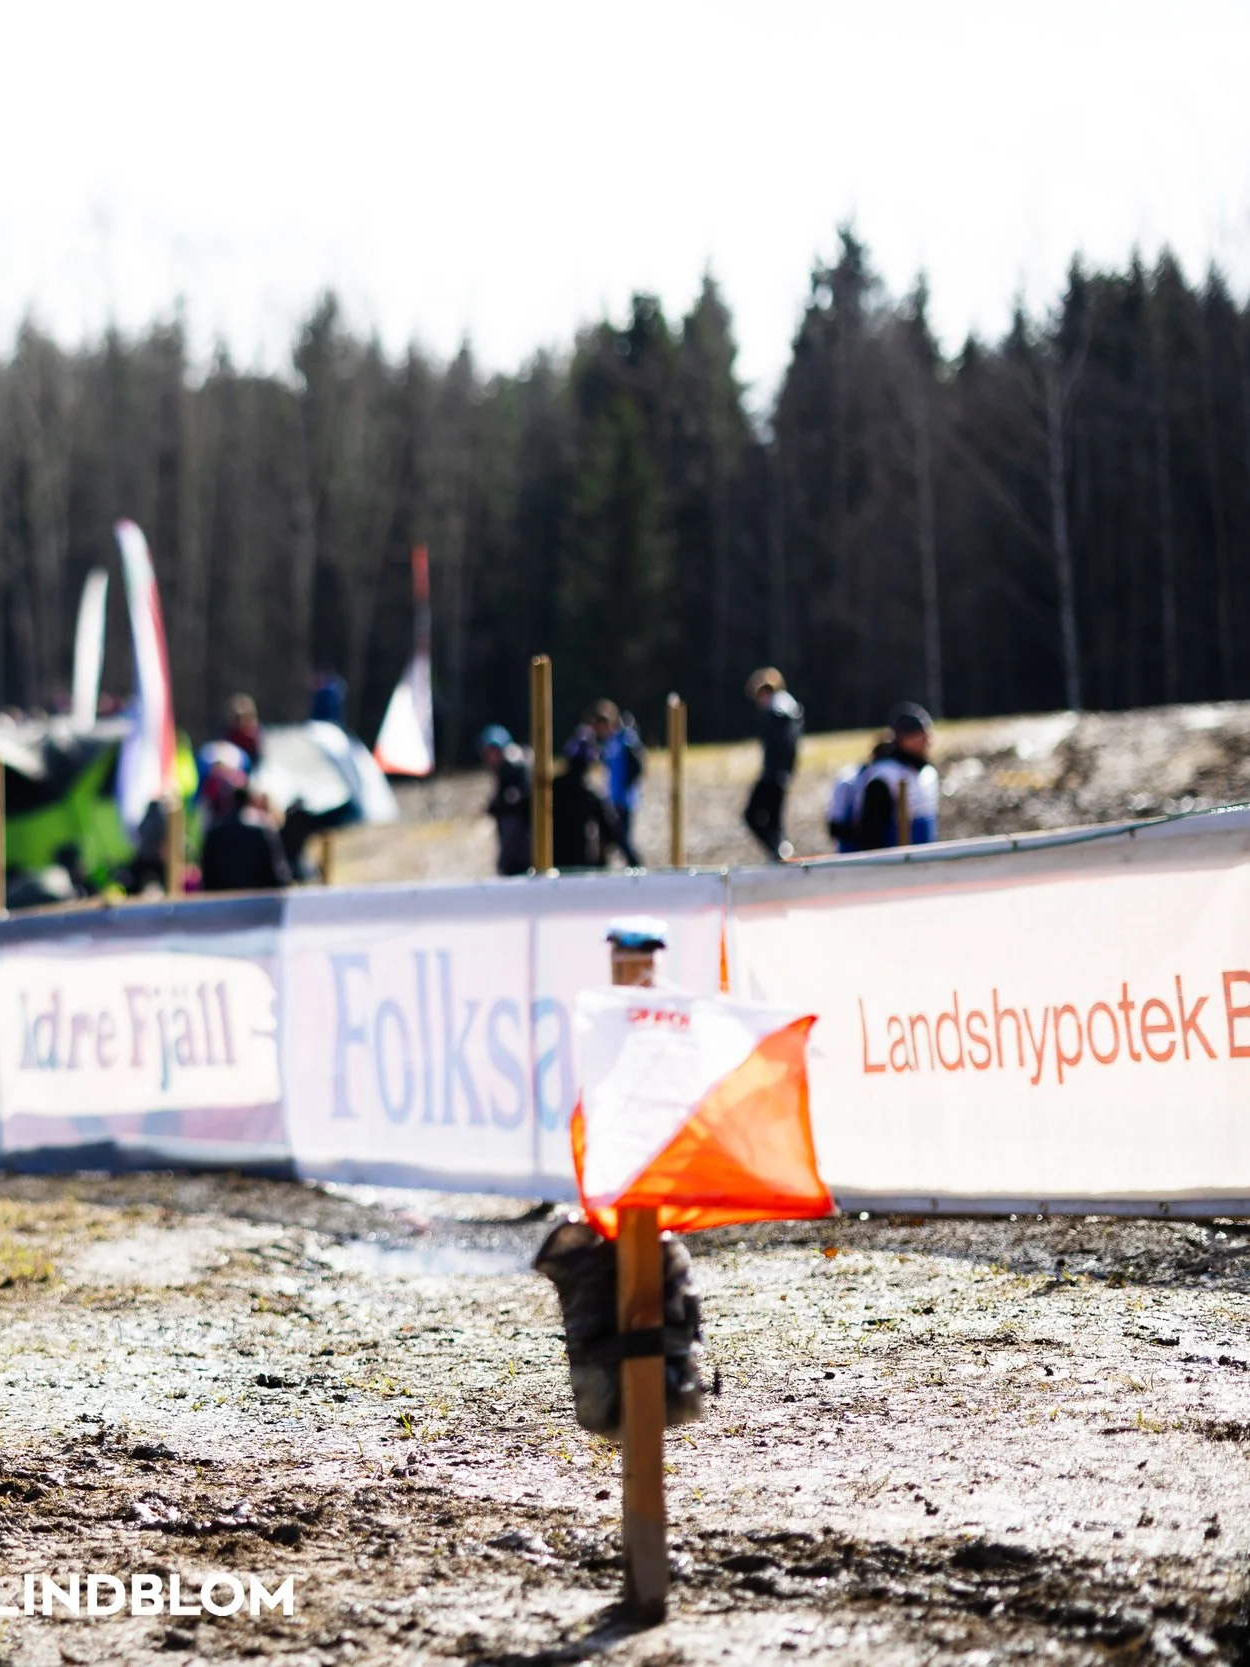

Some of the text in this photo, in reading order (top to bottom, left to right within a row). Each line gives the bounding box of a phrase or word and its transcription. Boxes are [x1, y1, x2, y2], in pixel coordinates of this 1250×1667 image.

[20, 979, 239, 1092] Idre Fjäll
[329, 949, 575, 1131] Folksa
[858, 975, 1218, 1086] Landshypotek
